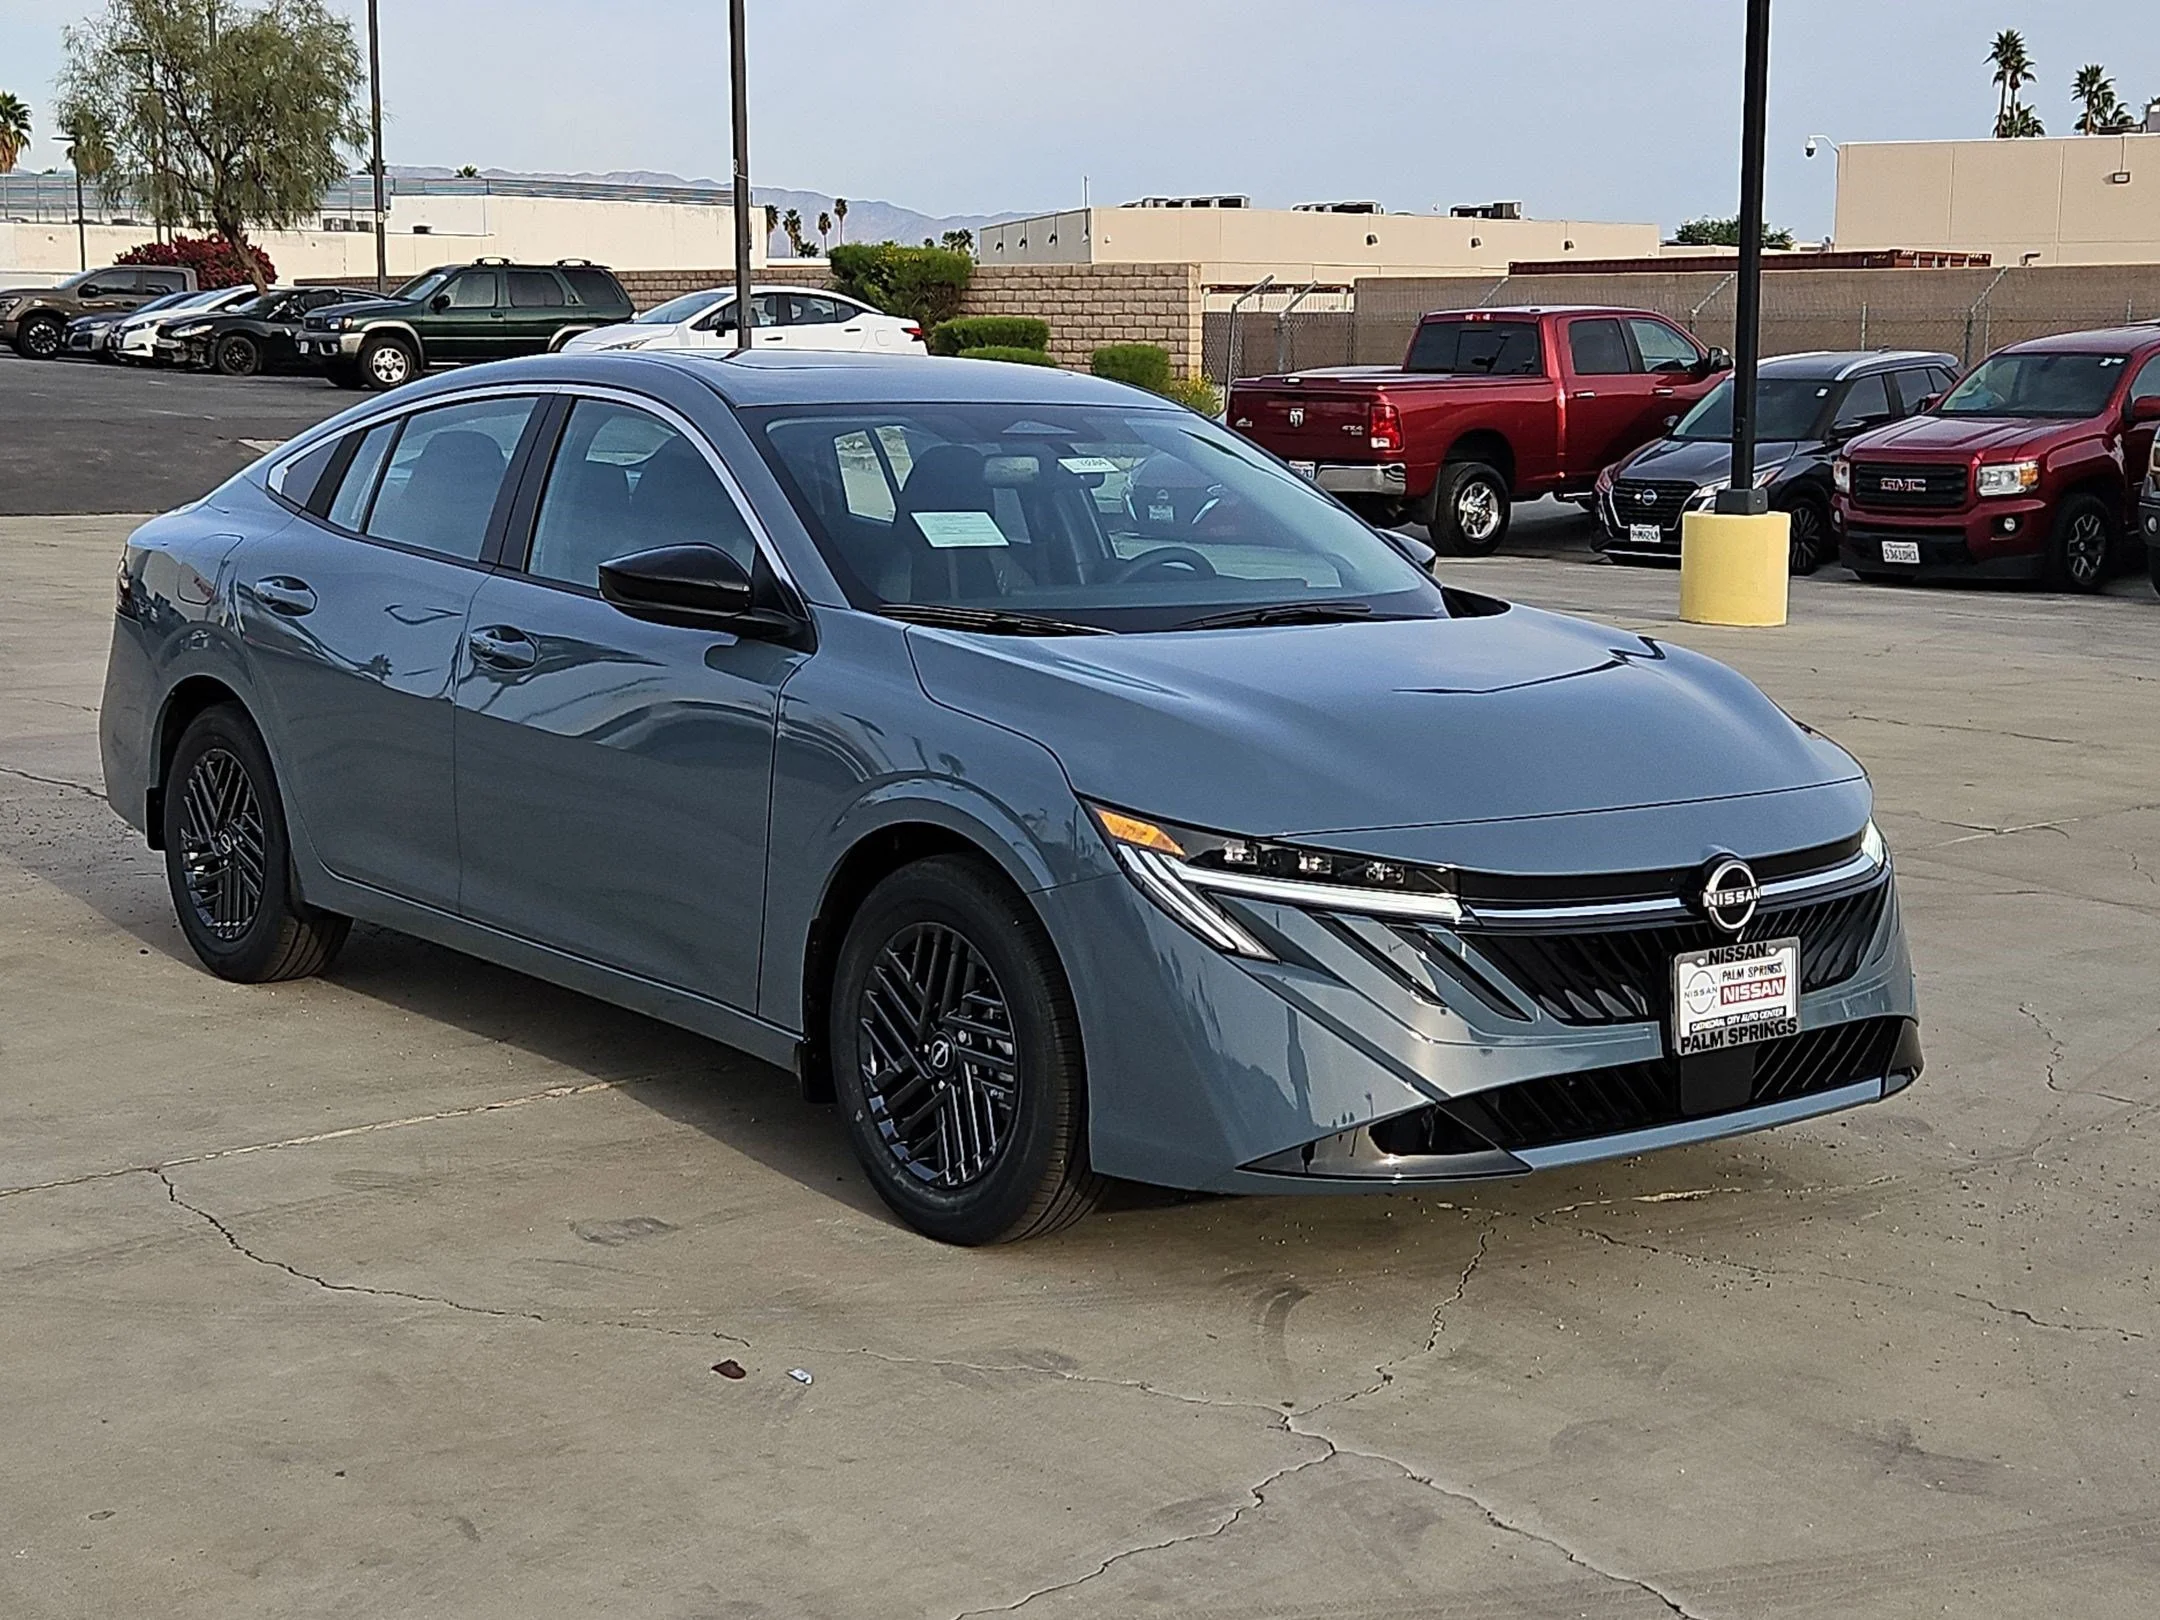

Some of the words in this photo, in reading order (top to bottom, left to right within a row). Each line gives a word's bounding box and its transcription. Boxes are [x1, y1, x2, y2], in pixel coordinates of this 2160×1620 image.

[1880, 477, 1926, 492] GMC
[1702, 887, 1762, 908] NISSAN
[1708, 942, 1767, 966] NISSAN
[1722, 967, 1744, 982] PALM
[1747, 962, 1783, 978] SPRINGS
[1684, 986, 1718, 999] NISSAN
[1723, 979, 1784, 1004] NISSAN
[1726, 1015, 1740, 1025] CITY
[1741, 1012, 1758, 1022] AUTO
[1759, 1008, 1785, 1019] CENTER
[1680, 1030, 1724, 1054] PALM
[1728, 1017, 1797, 1045] SPRINGS
